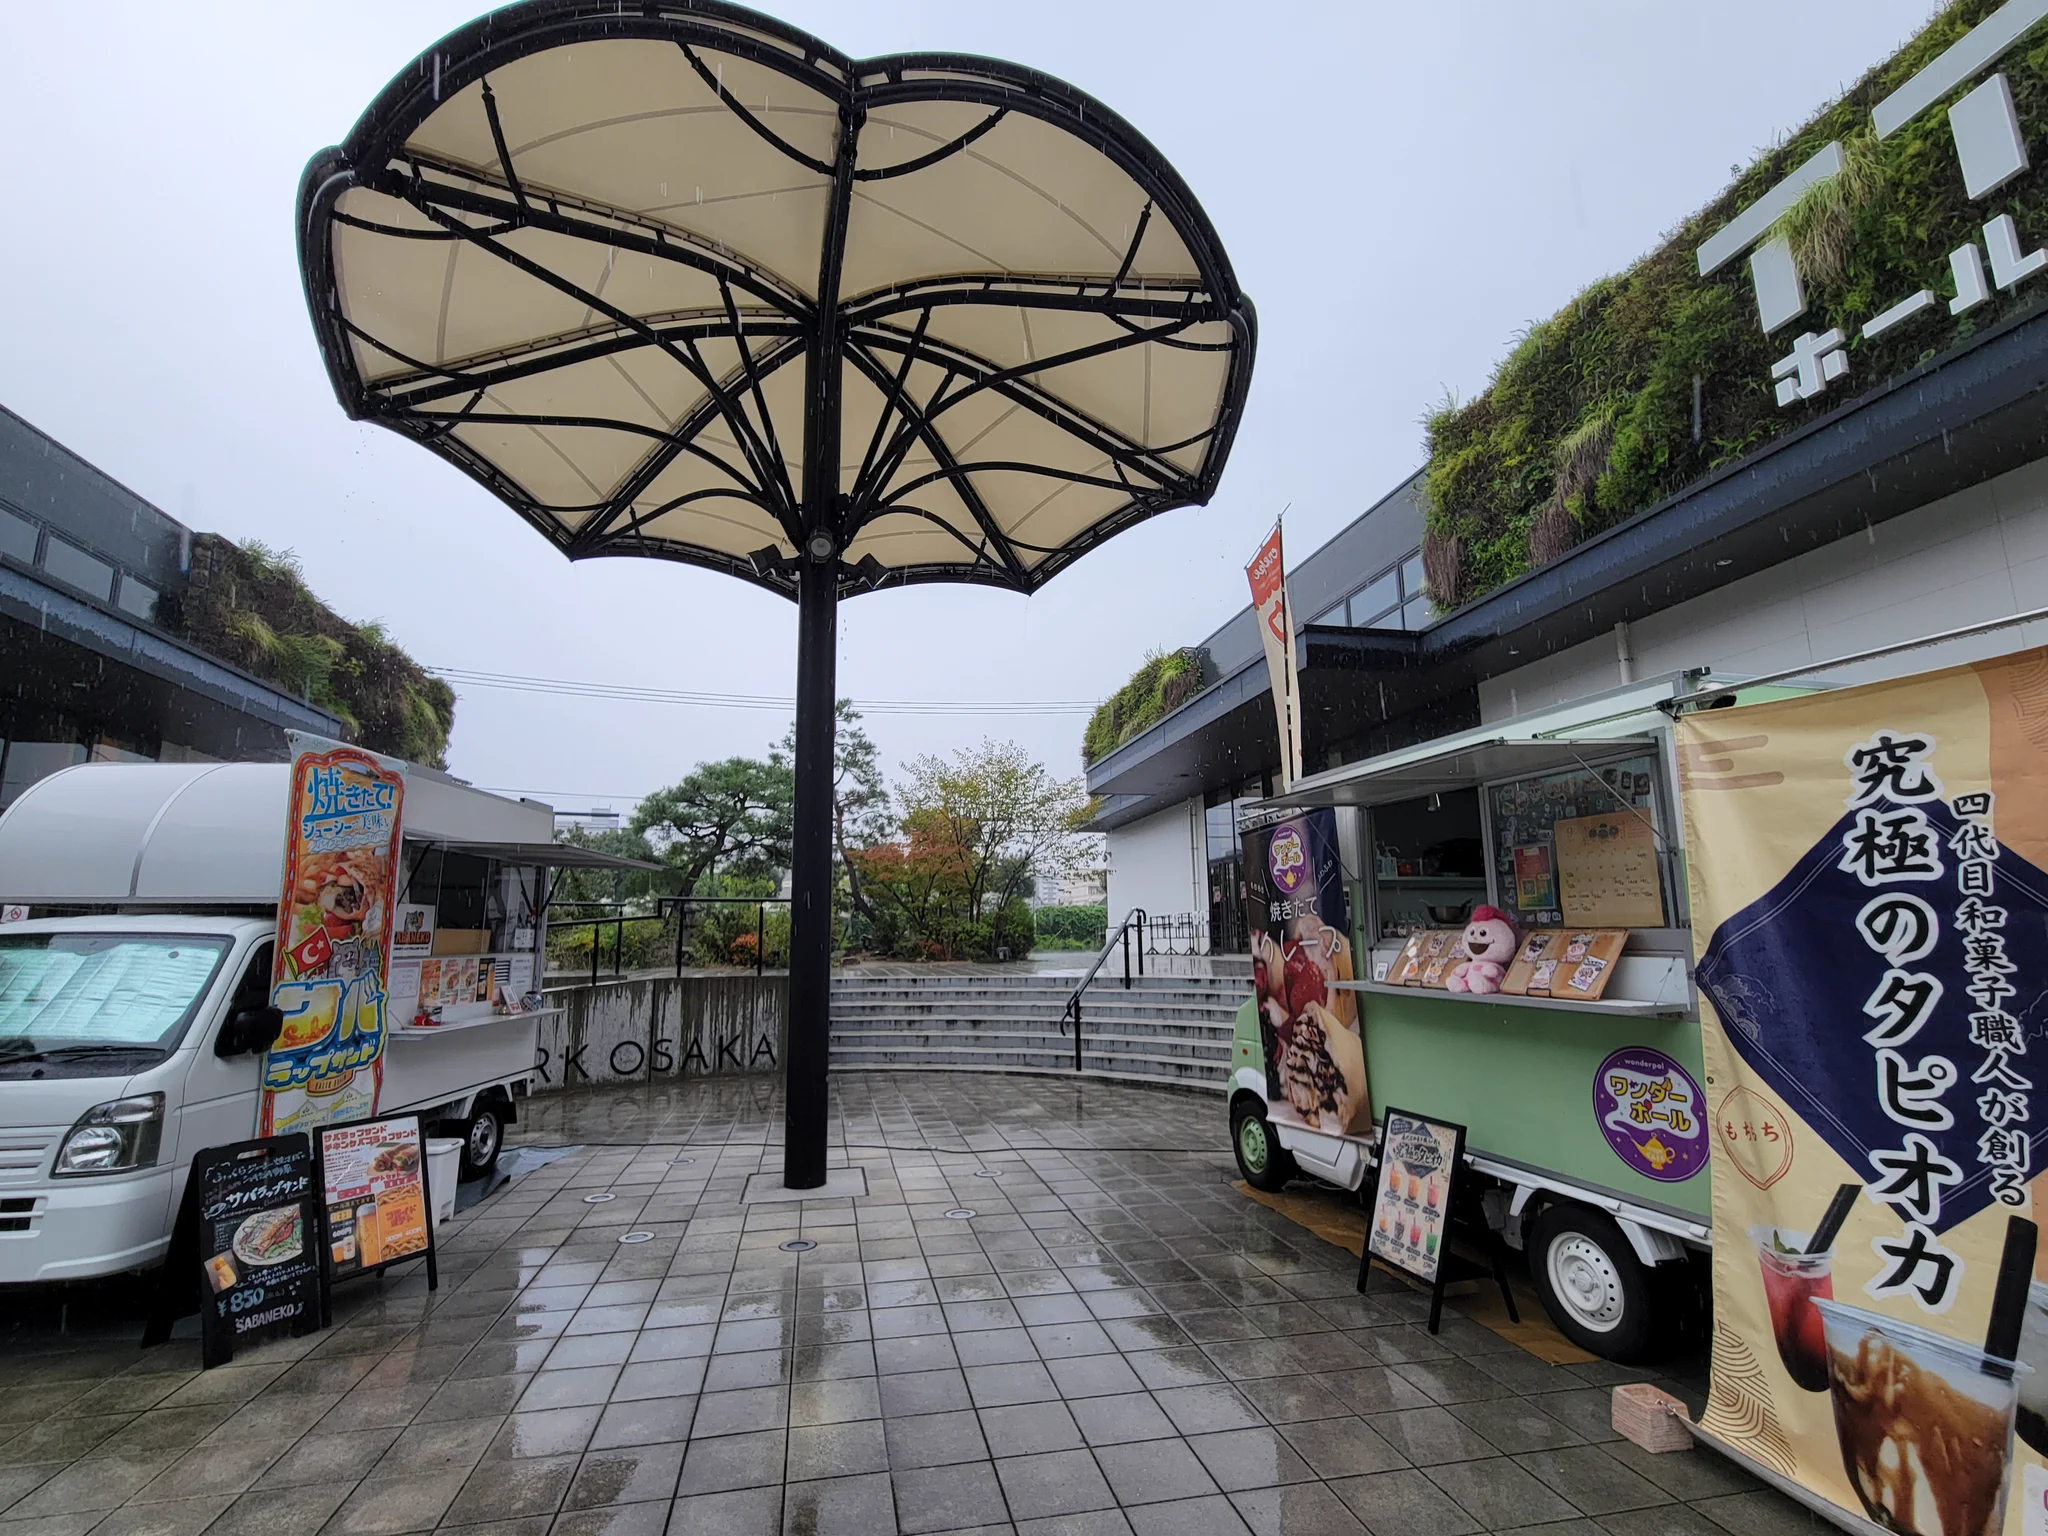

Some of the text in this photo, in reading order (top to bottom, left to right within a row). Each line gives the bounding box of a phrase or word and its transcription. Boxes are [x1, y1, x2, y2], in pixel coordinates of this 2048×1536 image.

[1771, 213, 2048, 408] ホール
[1269, 896, 1318, 922] 焼きたて
[394, 931, 431, 944] ABANEKO
[1260, 925, 1342, 964] クレープ
[1952, 791, 2031, 1206] 四代目和菓子職人が創る
[1850, 735, 1955, 1307] 究極のタピオカ
[609, 1032, 778, 1076] OSAKA
[1624, 1058, 1665, 1070] wonderpol
[1610, 1075, 1687, 1103] ワンダー
[235, 1303, 295, 1334] SABANEKO
